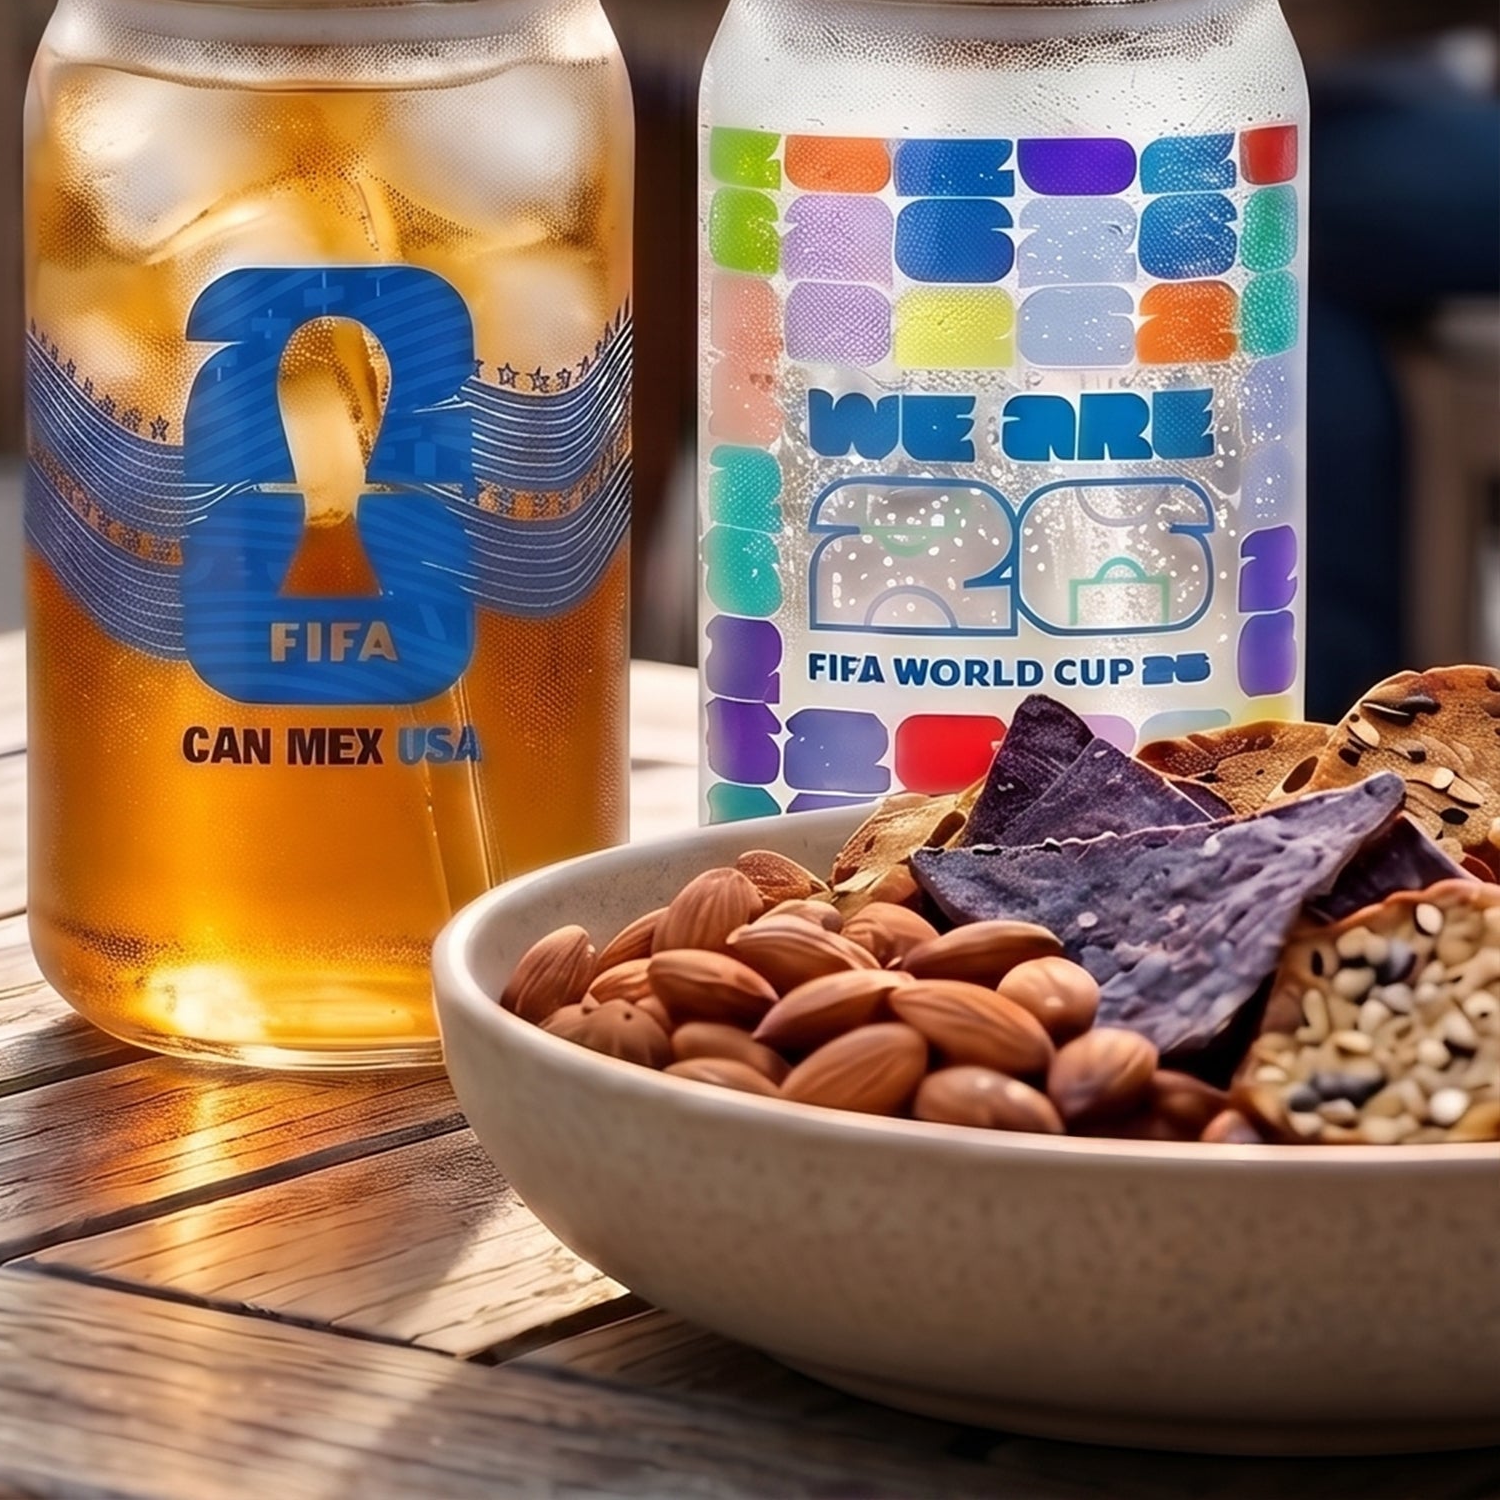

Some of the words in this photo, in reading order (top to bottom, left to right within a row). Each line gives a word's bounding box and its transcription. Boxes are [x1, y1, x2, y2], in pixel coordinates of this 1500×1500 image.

[808, 388, 976, 461] WE
[270, 621, 398, 663] FIFA
[808, 653, 885, 683] FIFA
[894, 657, 1044, 687] WORLD
[1054, 658, 1135, 686] CUP
[182, 726, 272, 765] CAN
[286, 727, 385, 766] MEX
[397, 725, 481, 766] USA
